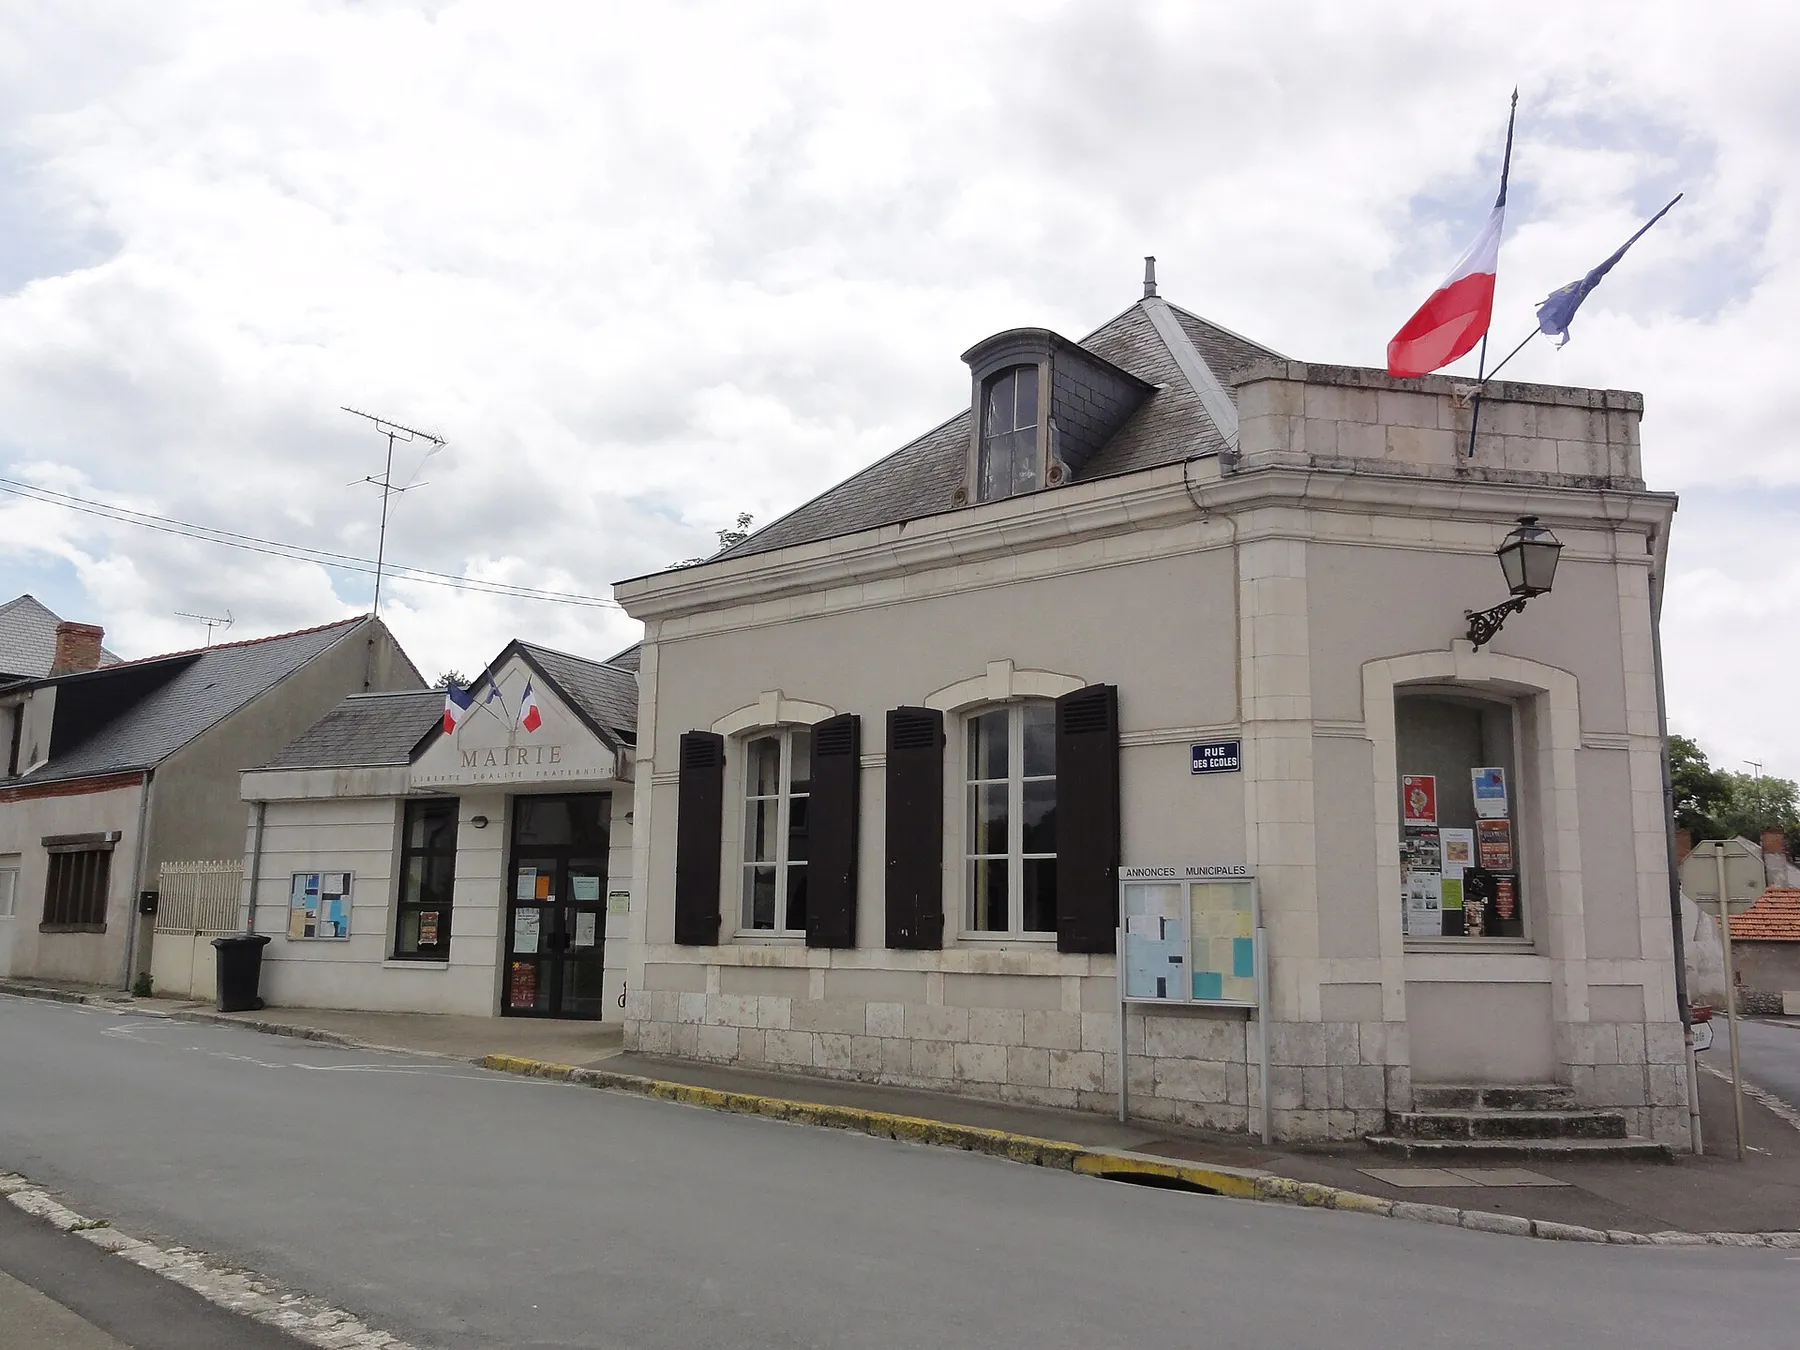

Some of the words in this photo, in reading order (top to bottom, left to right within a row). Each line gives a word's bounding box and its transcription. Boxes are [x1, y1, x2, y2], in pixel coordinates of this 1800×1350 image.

[461, 746, 562, 767] MAIRIE
[1204, 747, 1225, 756] RUE
[1193, 759, 1208, 769] DES
[1126, 868, 1175, 877] ANNONCES
[1185, 865, 1246, 876] MUNICIPALES
